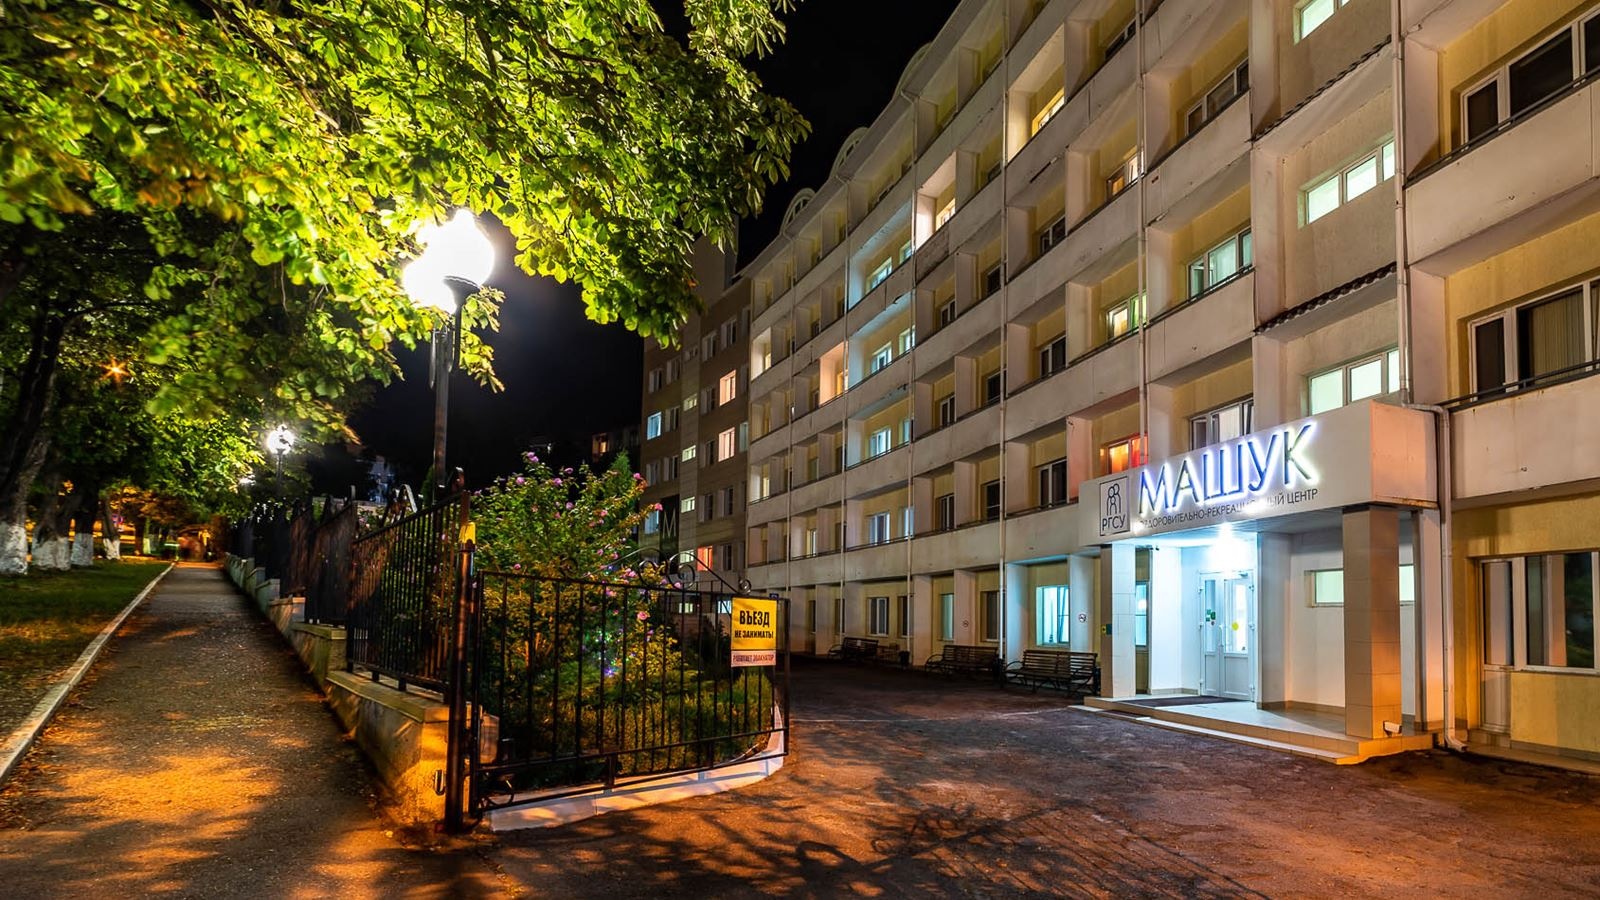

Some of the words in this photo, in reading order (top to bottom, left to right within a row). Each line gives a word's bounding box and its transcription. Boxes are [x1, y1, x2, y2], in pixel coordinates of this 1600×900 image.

[1138, 423, 1313, 514] МАШУК
[1287, 488, 1318, 504] ЦЕНТР
[1102, 514, 1126, 531] РГСУ
[739, 610, 770, 628] ВЪЕЗД
[734, 630, 742, 638] НЕ
[742, 630, 774, 639] ЗАНИМАТЬ!
